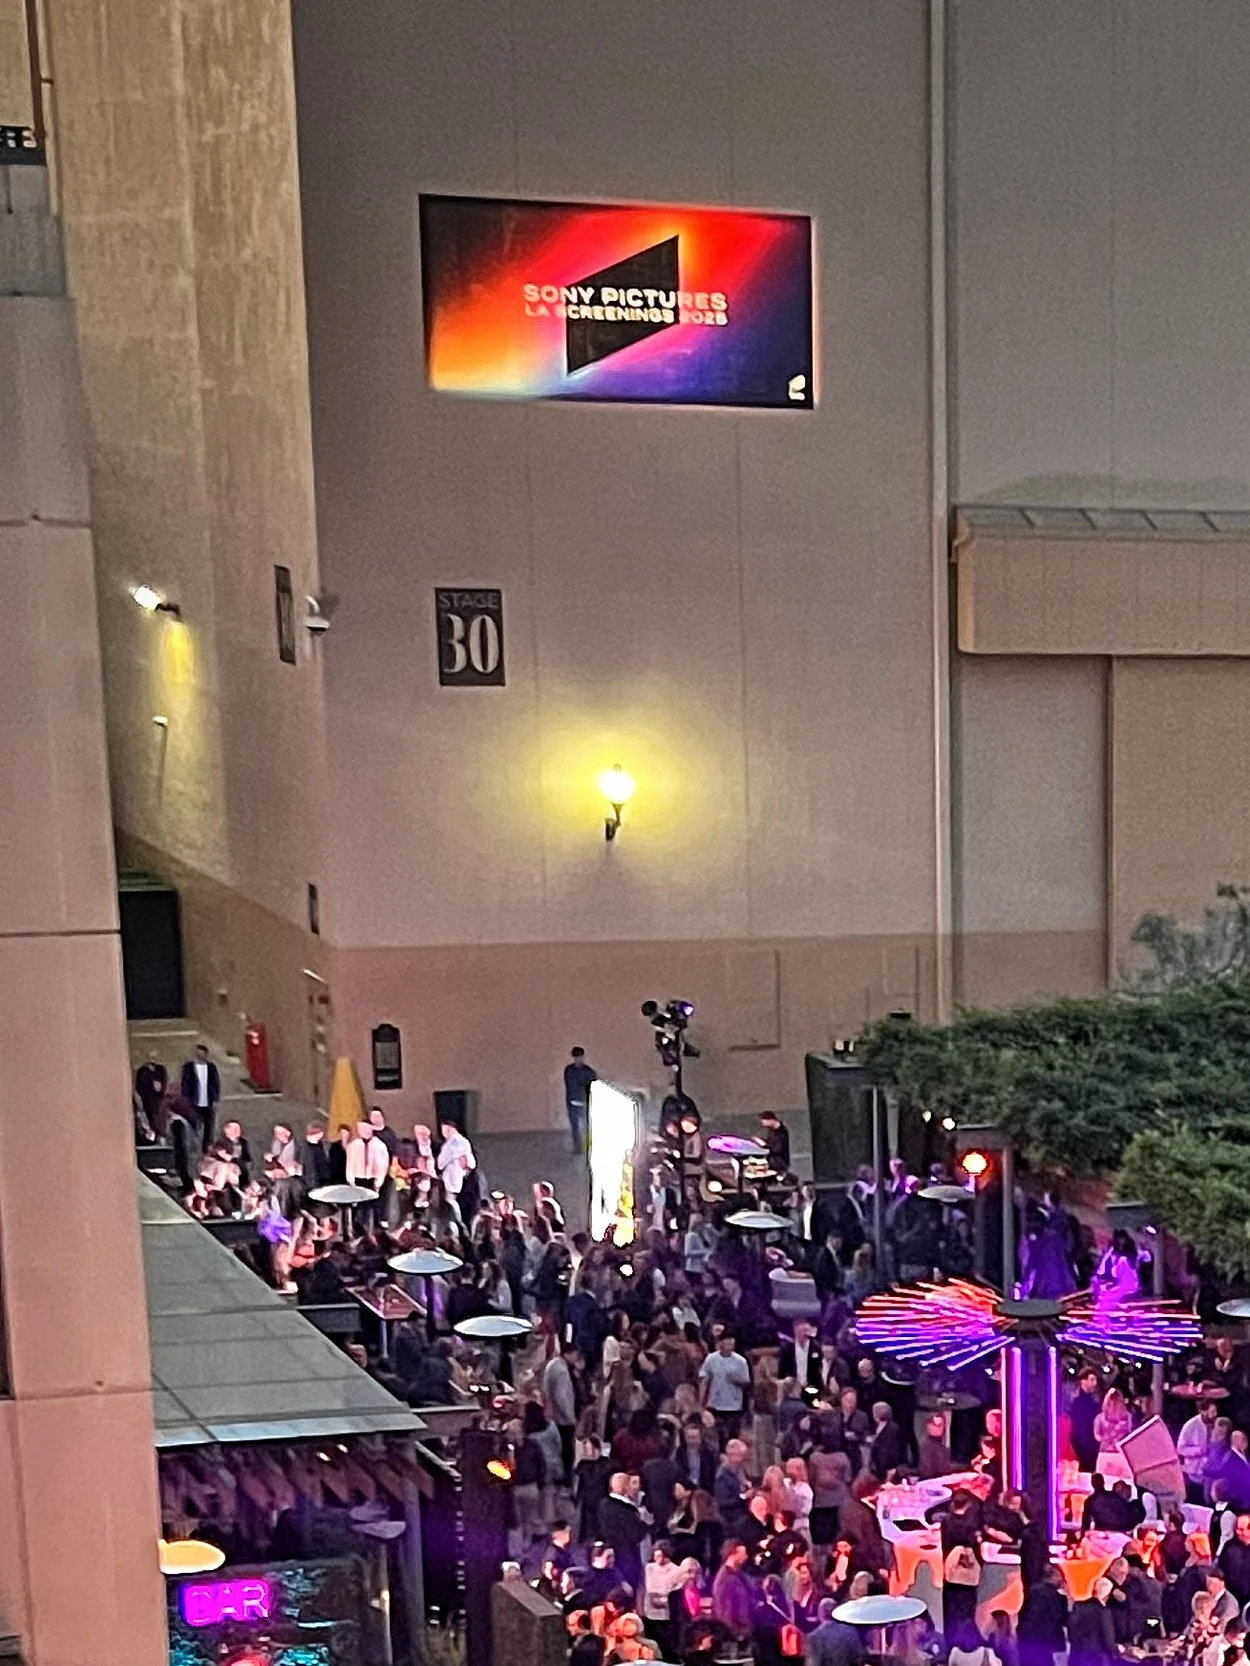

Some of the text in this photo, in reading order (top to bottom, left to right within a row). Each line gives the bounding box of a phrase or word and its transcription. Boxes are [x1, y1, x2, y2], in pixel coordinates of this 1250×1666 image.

[523, 284, 728, 311] SONY PICTURES
[525, 304, 549, 317] LA
[556, 304, 674, 323] SCREENINGS
[438, 592, 500, 609] STAGE
[440, 613, 500, 674] 30
[185, 1583, 269, 1627] BAR
